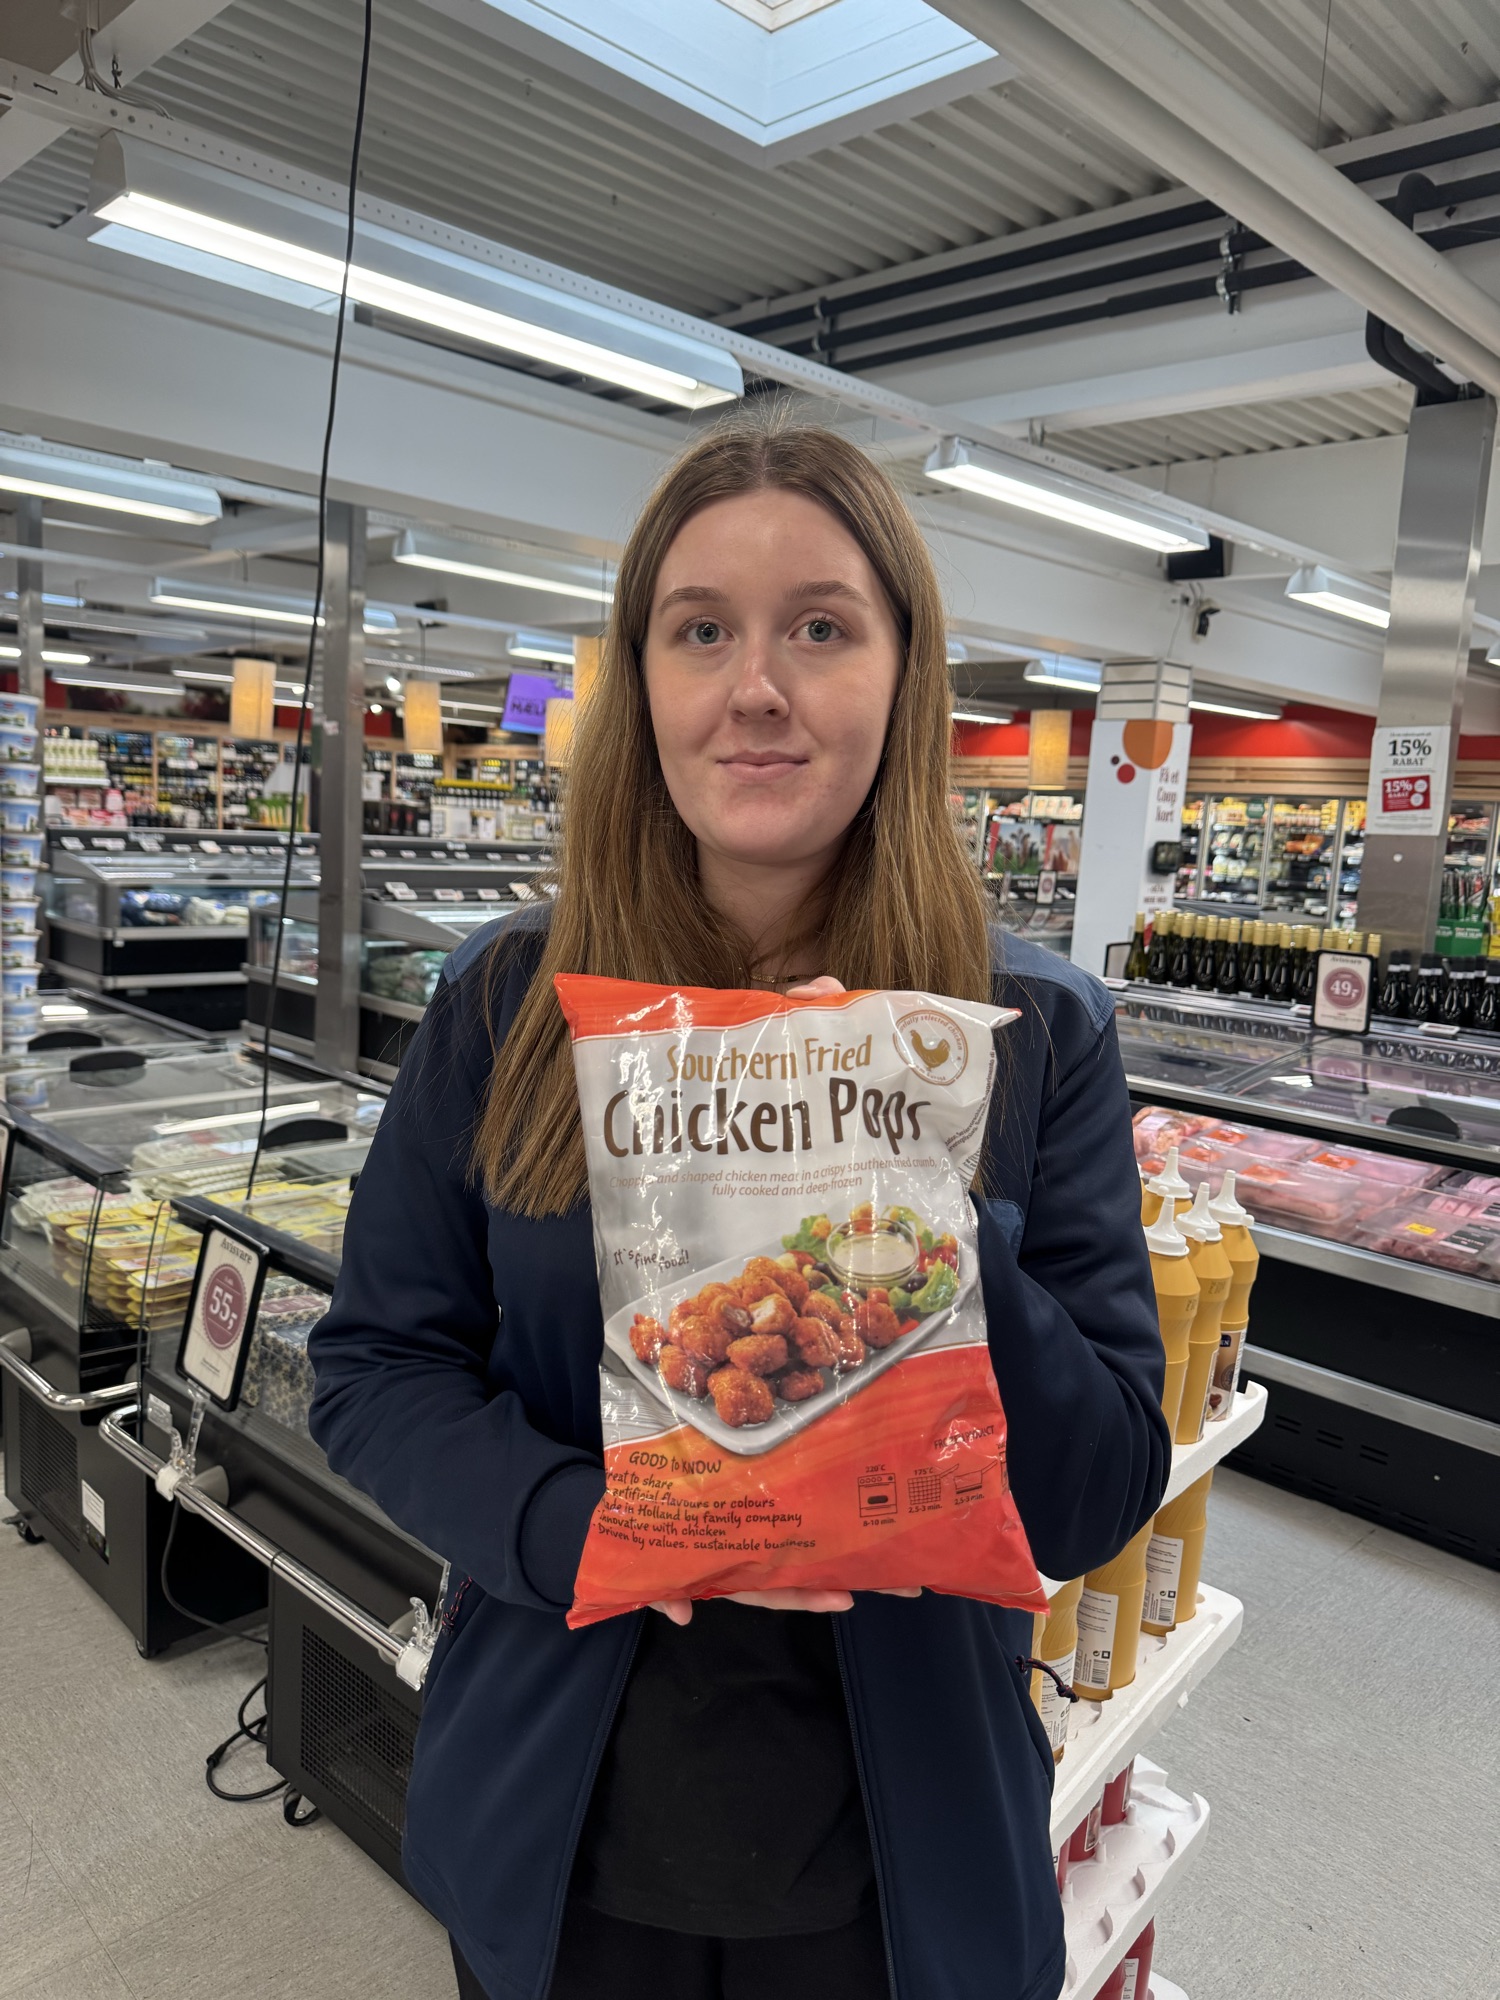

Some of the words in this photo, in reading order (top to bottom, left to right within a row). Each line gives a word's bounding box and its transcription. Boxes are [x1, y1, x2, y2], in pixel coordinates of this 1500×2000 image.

[1388, 738, 1432, 757] 15%
[1392, 758, 1424, 767] RABAT
[1384, 780, 1413, 793] 15%
[666, 1044, 797, 1083] Southern
[804, 1034, 873, 1075] Fried
[603, 1088, 813, 1158] Chicken
[829, 1077, 932, 1155] Pops
[657, 1172, 679, 1184] and
[681, 1170, 723, 1184] shaped
[726, 1170, 768, 1182] chicken
[801, 1170, 811, 1181] in
[813, 1171, 819, 1179] a
[821, 1164, 846, 1178] crispy
[848, 1157, 894, 1172] southern
[894, 1157, 911, 1169] fried
[912, 1156, 938, 1169] crumb,
[712, 1183, 737, 1198] fully
[739, 1184, 779, 1196] cooked
[781, 1184, 804, 1196] and
[806, 1176, 863, 1195] deep-frozen
[221, 1238, 253, 1264] Avisvare
[634, 1252, 658, 1270] fine
[629, 1451, 668, 1470] GOOD
[671, 1456, 680, 1472] to
[682, 1459, 722, 1475] KNOW
[631, 1472, 639, 1485] to
[642, 1474, 673, 1490] share
[613, 1486, 659, 1504] artificial
[661, 1491, 709, 1508] flavours
[713, 1500, 726, 1509] or
[730, 1495, 775, 1509] colours
[927, 1503, 943, 1511] min.
[599, 1510, 649, 1531] Innovative
[652, 1523, 678, 1539] with
[682, 1524, 726, 1537] chicken
[624, 1502, 634, 1514] in
[638, 1504, 681, 1521] Holland
[684, 1509, 699, 1528] by
[703, 1511, 742, 1529] family
[745, 1513, 802, 1528] company
[863, 1519, 879, 1527] 8-10
[880, 1518, 896, 1526] min.
[598, 1522, 629, 1541] Driven
[632, 1532, 645, 1550] by
[649, 1535, 689, 1549] values,
[693, 1538, 760, 1551] sustainable
[764, 1538, 816, 1550] business
